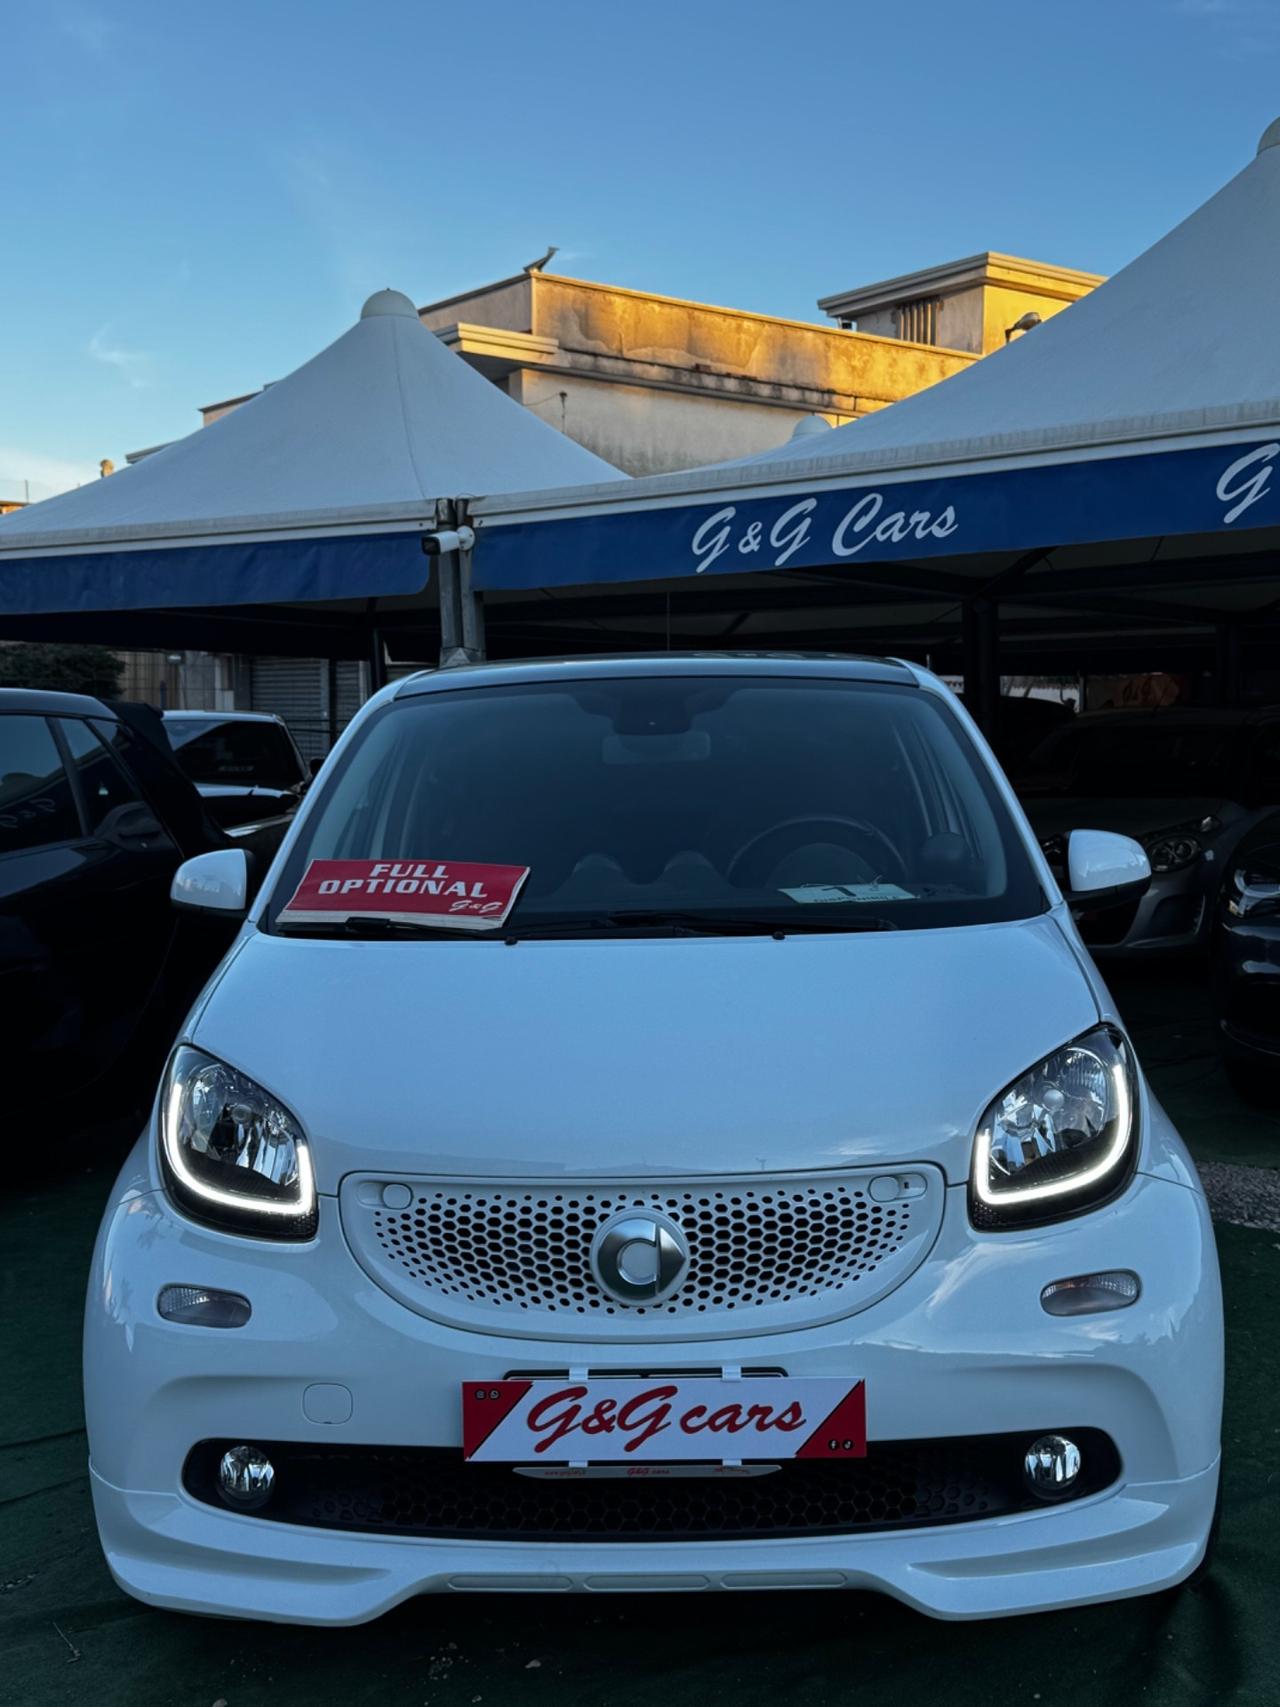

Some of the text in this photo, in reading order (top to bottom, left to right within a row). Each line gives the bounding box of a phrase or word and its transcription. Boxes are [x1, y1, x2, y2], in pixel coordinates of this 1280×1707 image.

[832, 492, 959, 557] Cars
[318, 879, 488, 898] OPTIONAL
[369, 863, 449, 879] FULL
[526, 1385, 807, 1454] G&G cars
